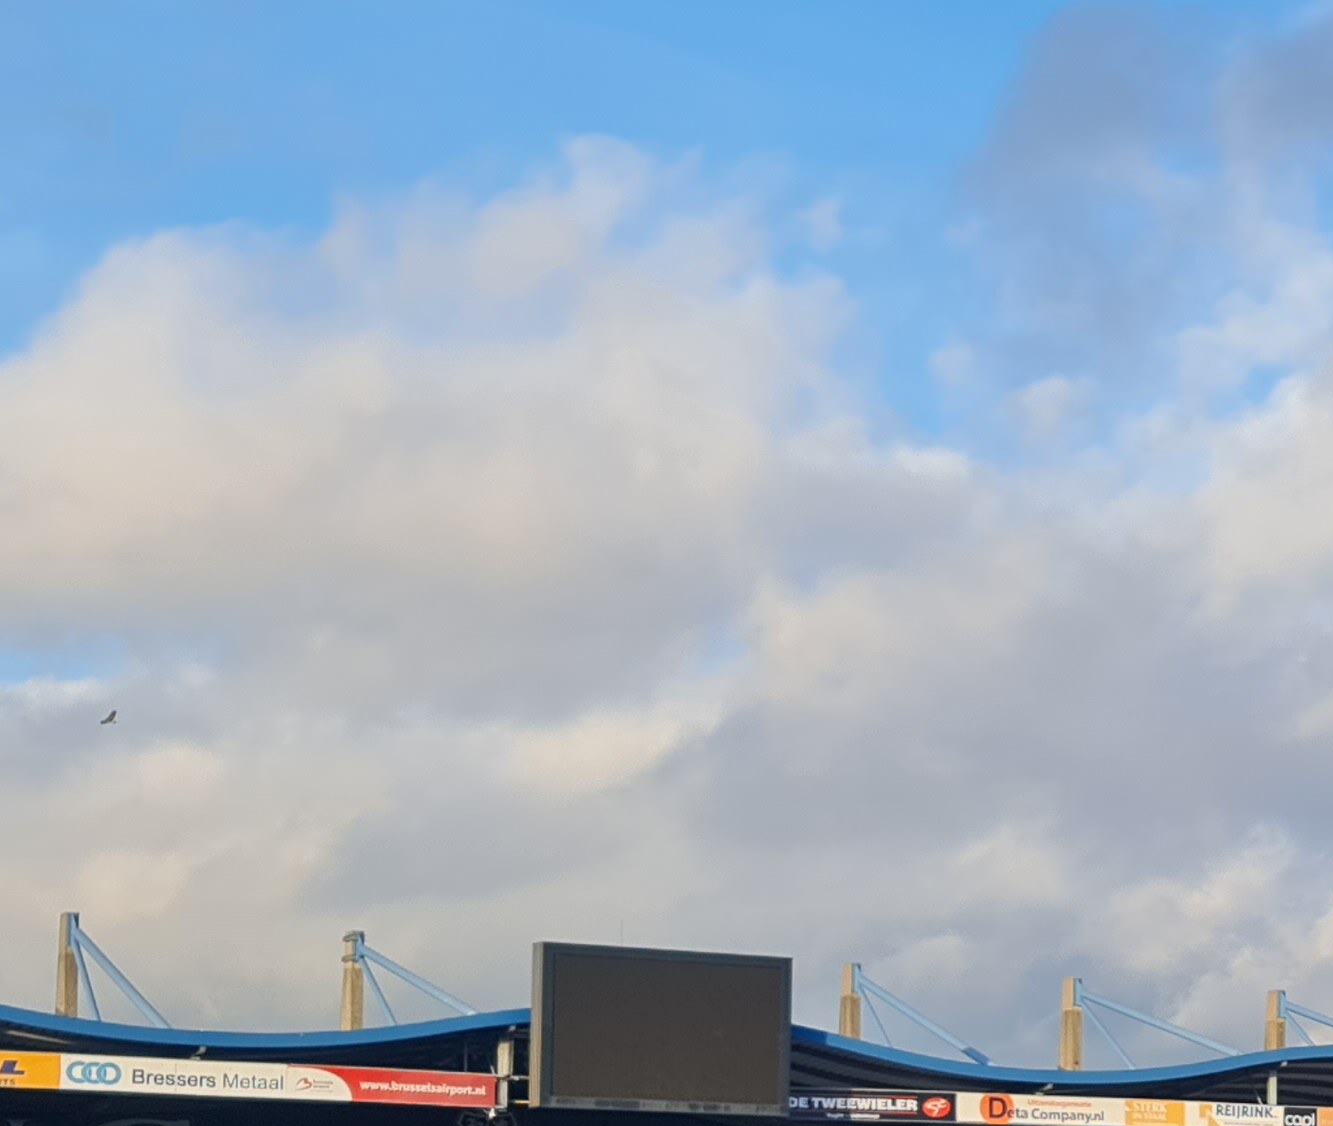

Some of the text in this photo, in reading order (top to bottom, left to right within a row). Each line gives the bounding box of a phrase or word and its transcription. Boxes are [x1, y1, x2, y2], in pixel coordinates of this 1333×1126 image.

[132, 1069, 284, 1090] Bressers Metaal
[789, 1096, 918, 1111] DE TWEEWIELER
[989, 1097, 1104, 1125] Deta Company.nl
[1216, 1104, 1273, 1119] REIJRINK
